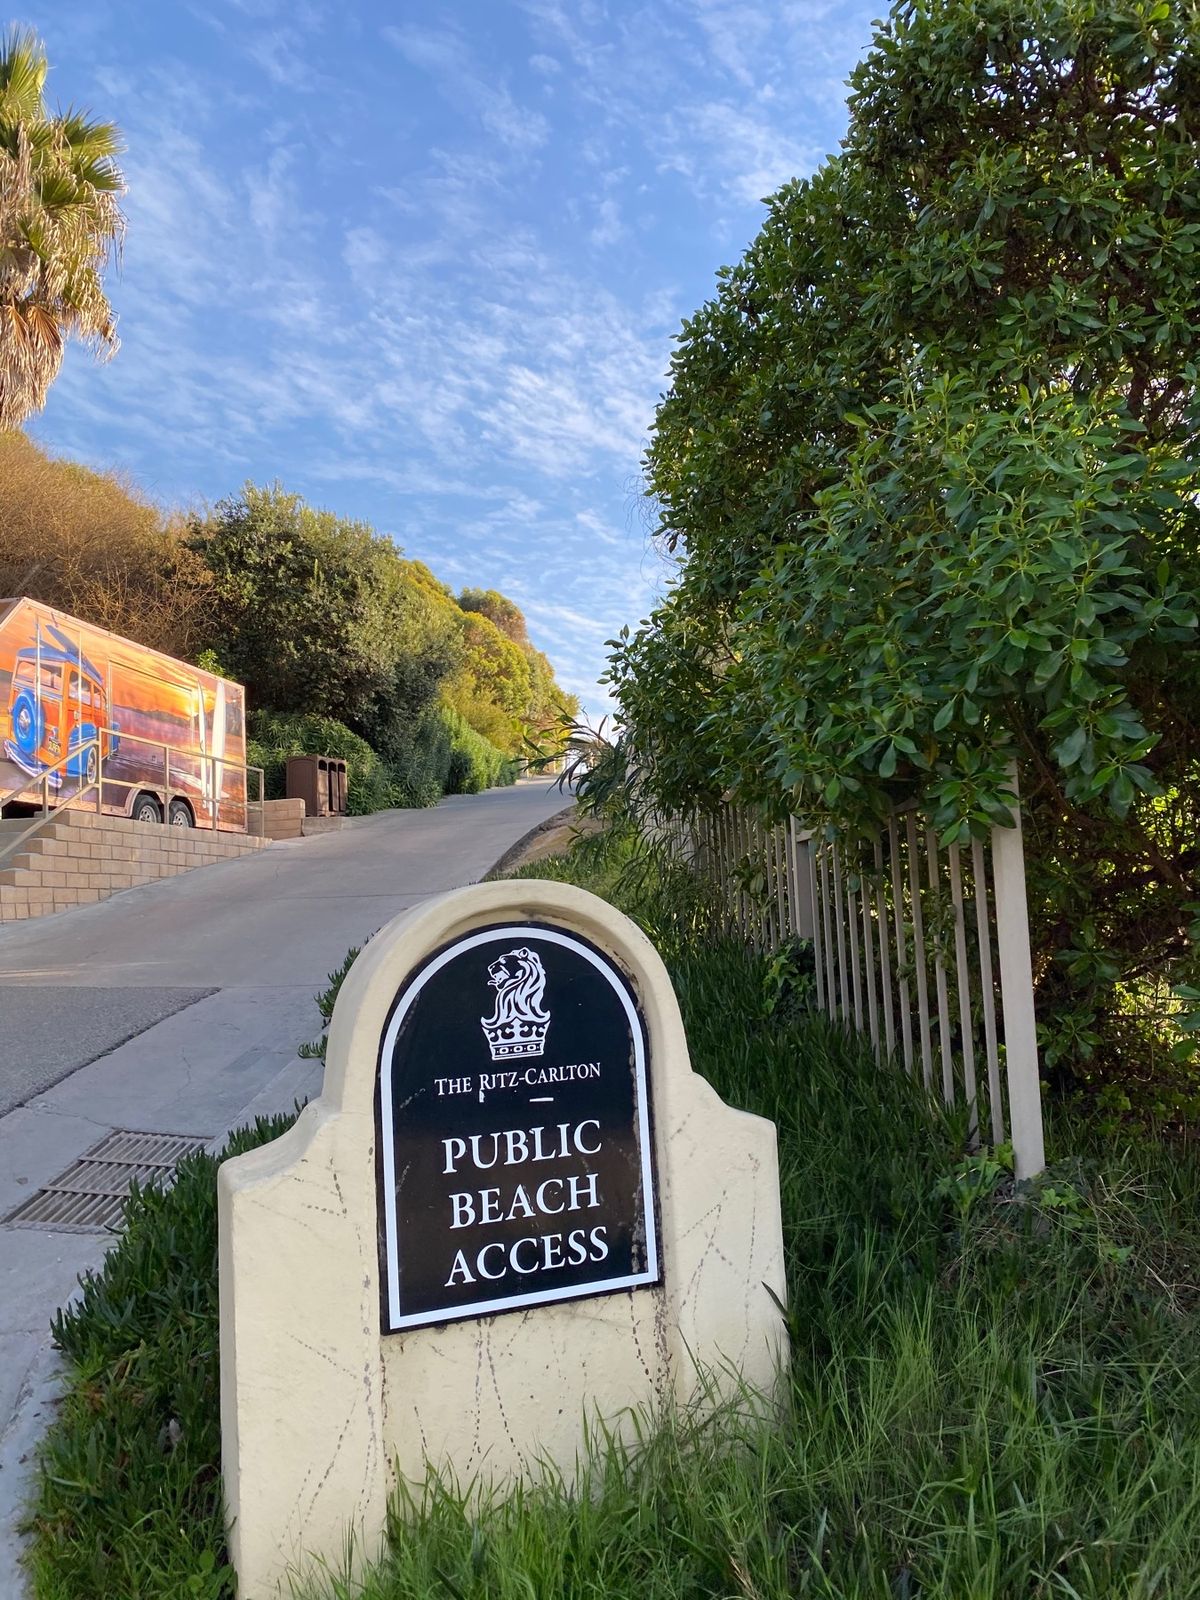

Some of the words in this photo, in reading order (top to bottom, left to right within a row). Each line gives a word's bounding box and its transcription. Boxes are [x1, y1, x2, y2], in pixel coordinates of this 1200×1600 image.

[434, 1077, 473, 1096] THE
[479, 1062, 601, 1091] RITZ-CARLTON
[441, 1119, 602, 1174] PUBLIC
[448, 1173, 601, 1230] BEACH
[444, 1226, 609, 1287] ACCESS
